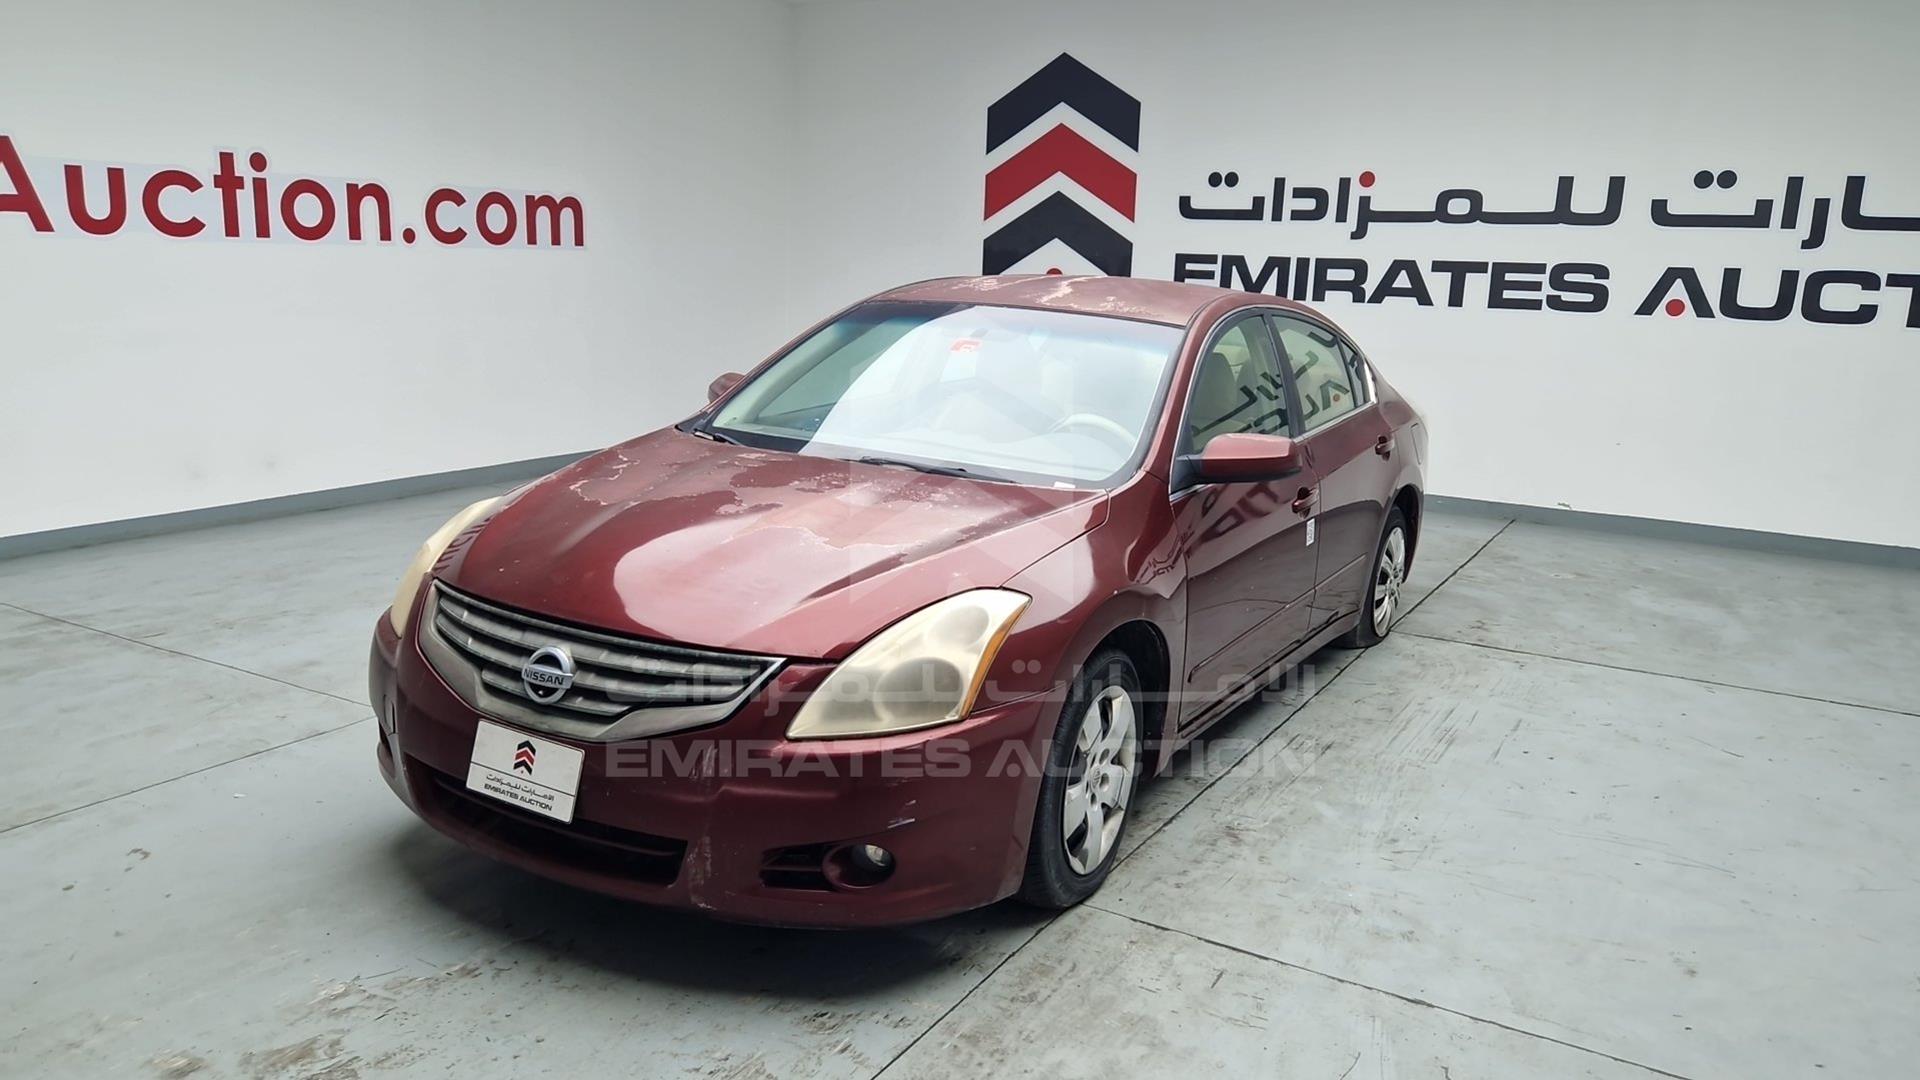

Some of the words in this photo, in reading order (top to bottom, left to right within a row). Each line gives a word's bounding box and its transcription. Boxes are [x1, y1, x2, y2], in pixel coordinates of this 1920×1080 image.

[1179, 171, 1626, 240] للمزادات
[523, 668, 565, 686] NISSAN
[484, 783, 519, 800] EMIRATES
[519, 795, 553, 811] AUCTION
